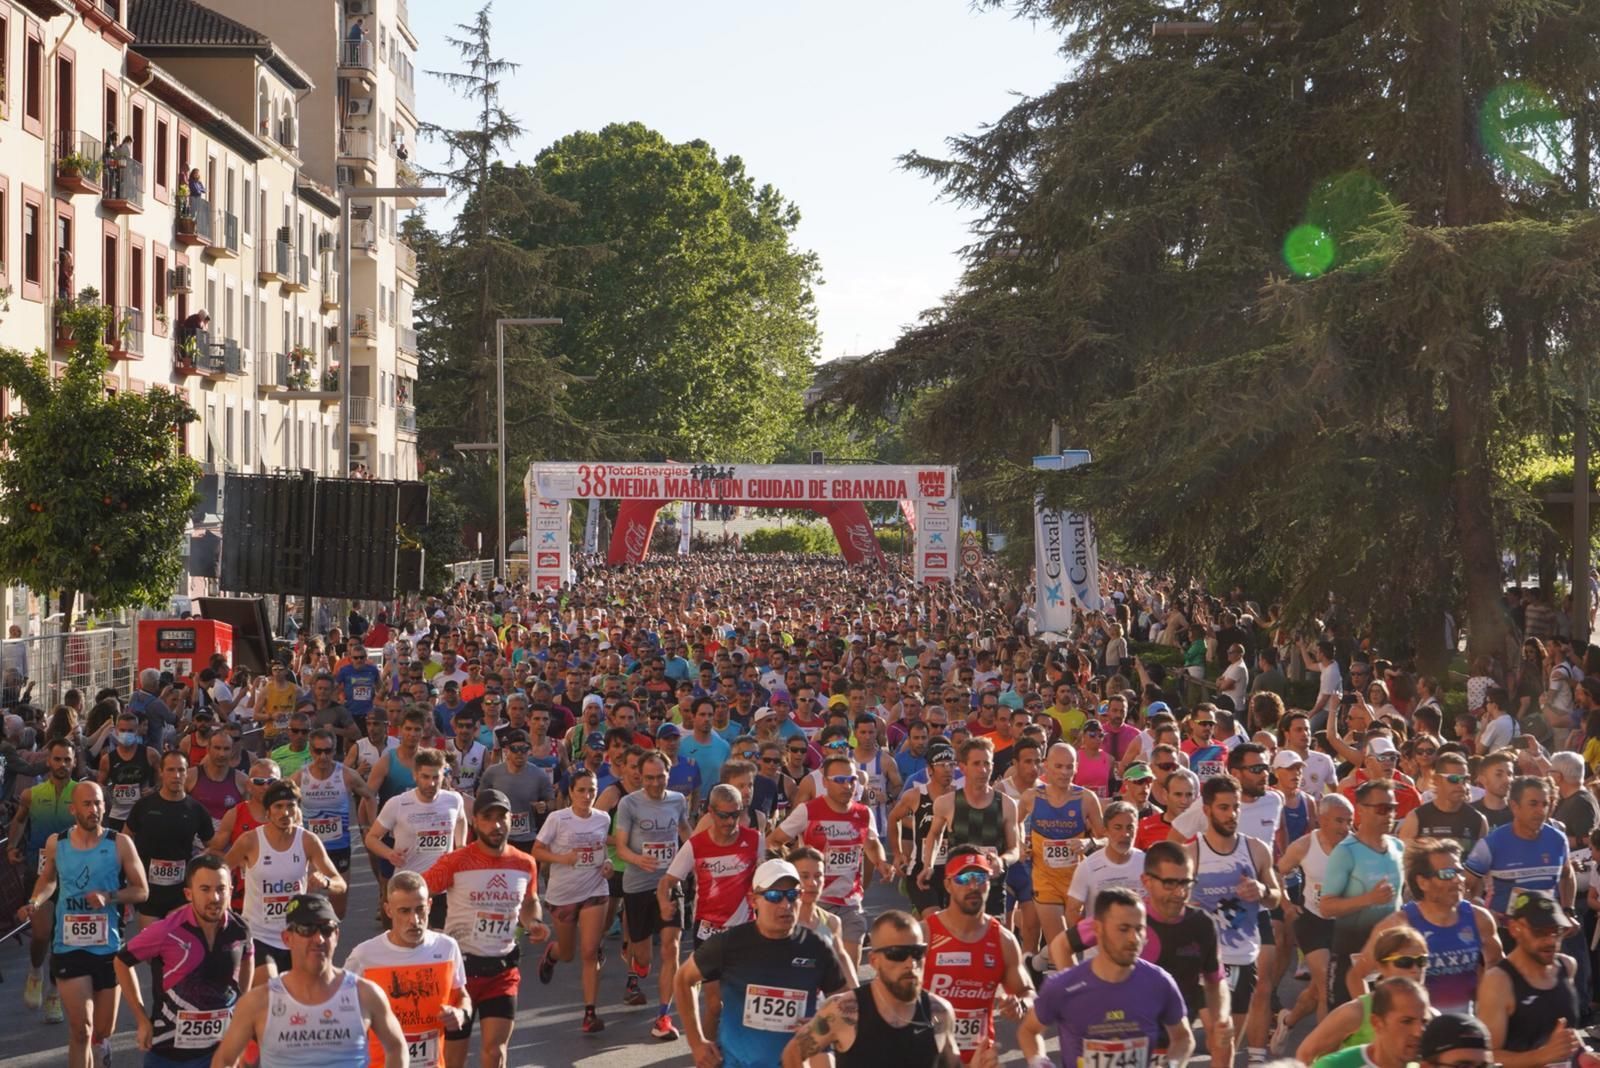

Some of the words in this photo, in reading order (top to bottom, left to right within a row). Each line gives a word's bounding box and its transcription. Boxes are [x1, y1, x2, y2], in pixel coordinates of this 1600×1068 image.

[607, 465, 689, 478] TotalEnergies
[577, 464, 607, 497] 38
[609, 478, 658, 497] MEDIA
[749, 479, 804, 499] CIUDAD
[808, 479, 828, 499] DE
[831, 479, 908, 499] GRANADA
[1043, 512, 1061, 580] CaixaB
[1069, 512, 1088, 586] CaixaB
[115, 789, 136, 798] 2769
[312, 822, 338, 834] 6050
[419, 835, 447, 848] 2028
[581, 852, 595, 863] 96
[1047, 846, 1075, 858] 288
[152, 865, 180, 877] 3885
[72, 922, 97, 936] 658
[478, 919, 511, 934] 3174
[752, 997, 797, 1018] 1526
[181, 1020, 223, 1036] 2569
[278, 1027, 351, 1042] MARACENA
